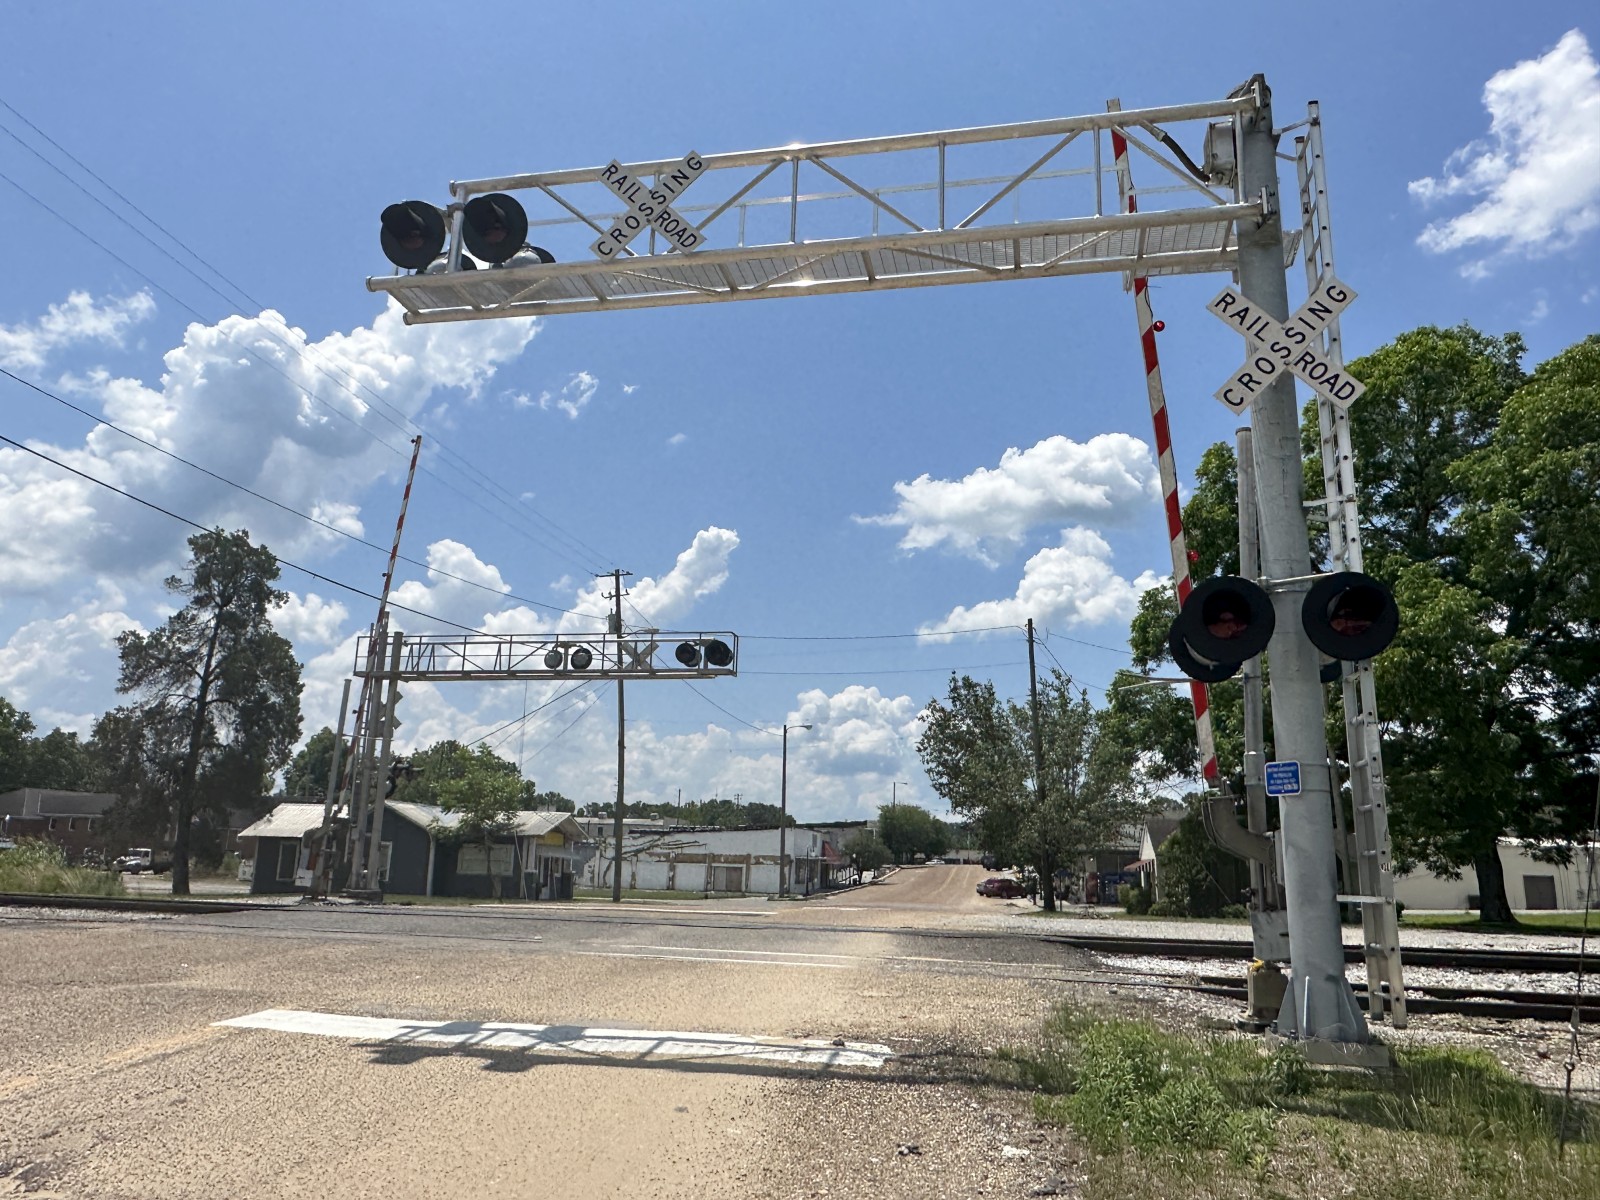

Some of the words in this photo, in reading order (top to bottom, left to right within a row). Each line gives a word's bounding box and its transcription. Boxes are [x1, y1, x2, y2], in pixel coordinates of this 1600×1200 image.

[597, 157, 703, 256] CROSSING
[602, 164, 641, 204] RAIL
[653, 210, 698, 248] ROAD
[1214, 291, 1270, 342] RAIL
[1293, 351, 1356, 401] ROAD
[1223, 285, 1348, 407] CROSSING
